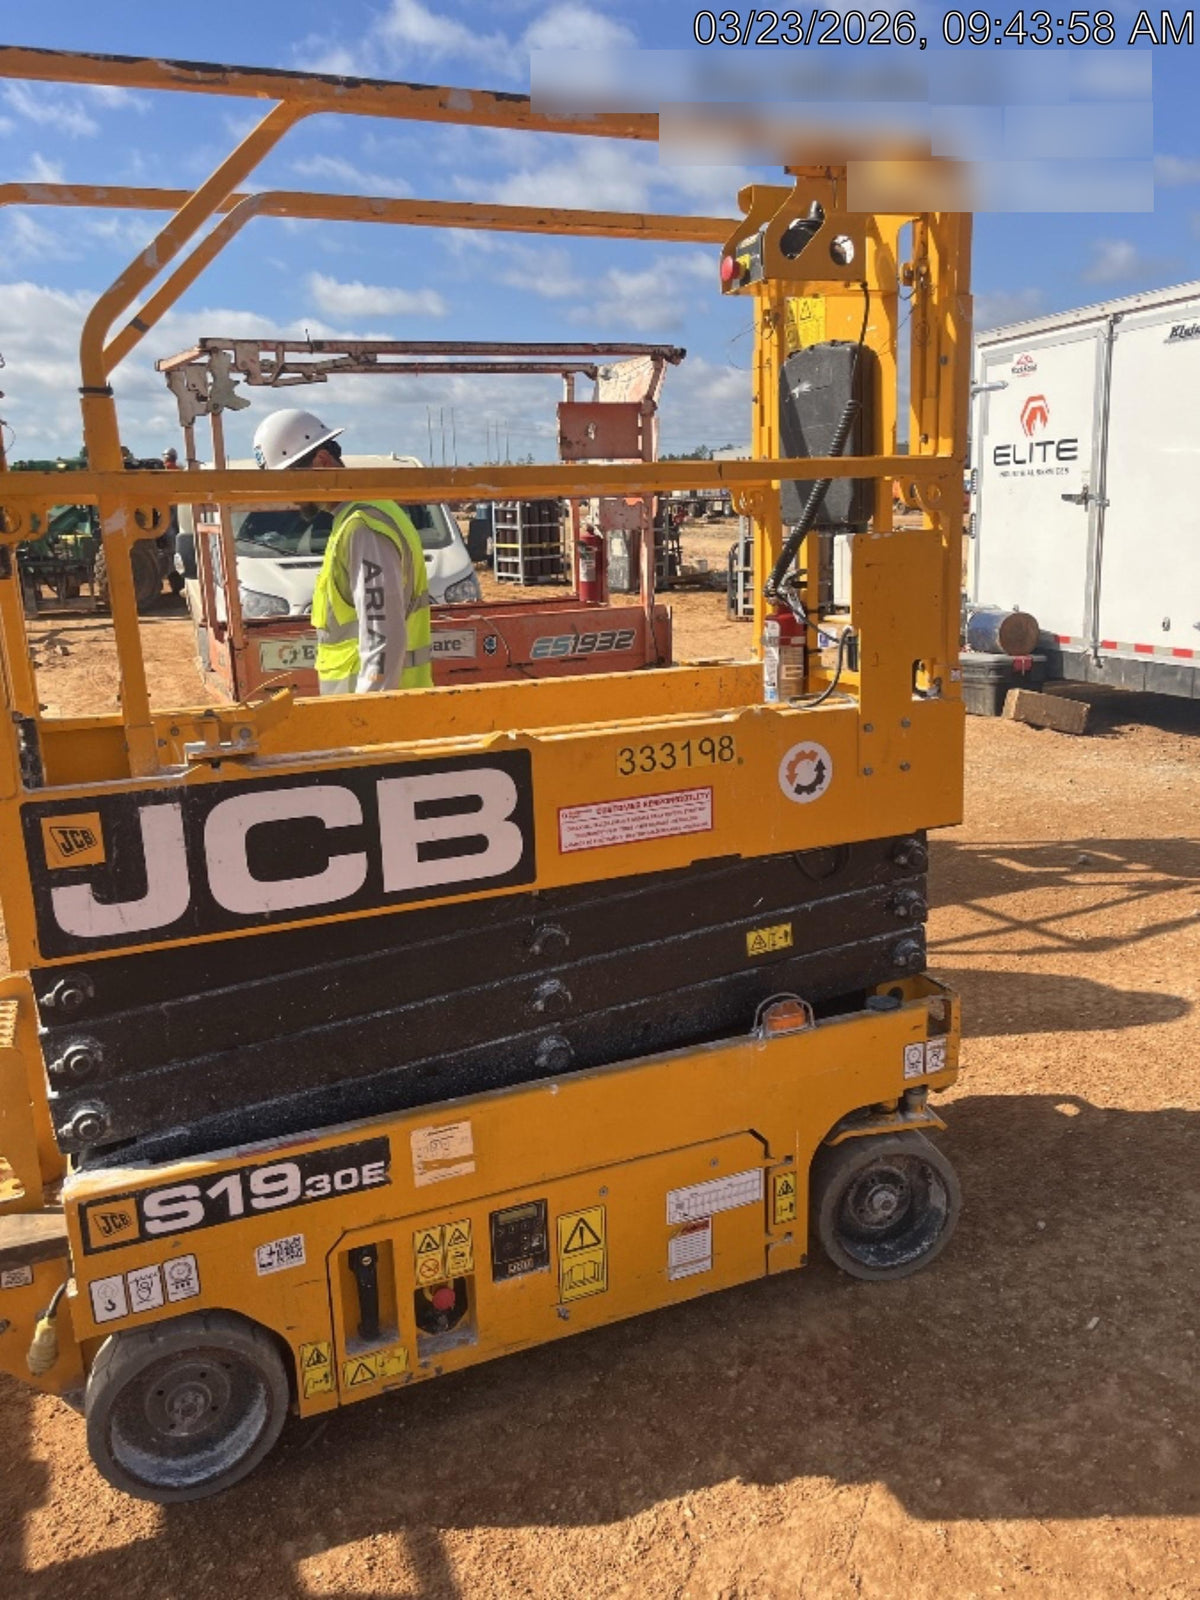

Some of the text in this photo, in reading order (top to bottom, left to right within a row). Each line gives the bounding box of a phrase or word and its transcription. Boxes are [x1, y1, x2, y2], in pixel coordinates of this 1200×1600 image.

[993, 438, 1078, 466] ELITE
[362, 558, 387, 675] ARIAT
[531, 629, 637, 660] ES1932
[618, 735, 735, 776] 333198
[50, 767, 524, 938] JCB
[57, 829, 95, 854] JCB
[101, 1211, 131, 1235] JCB
